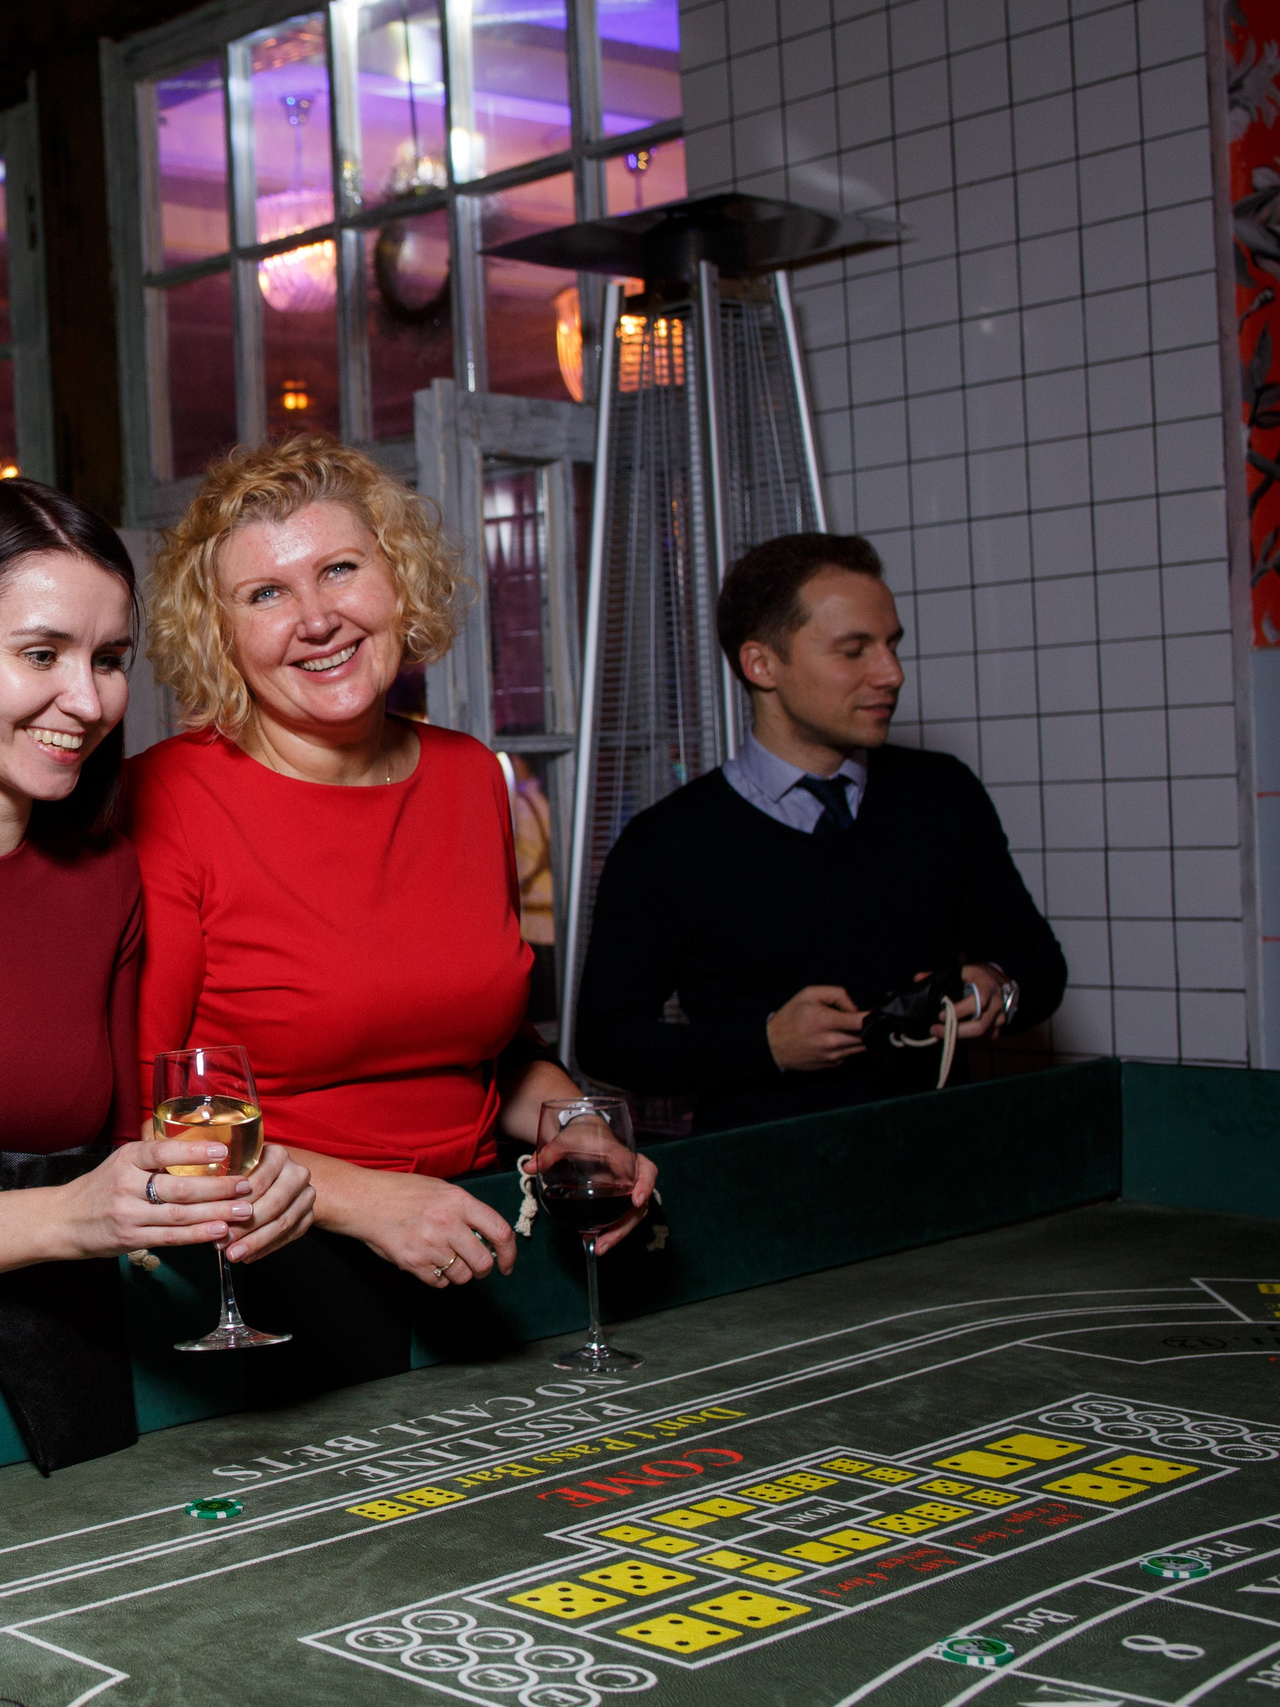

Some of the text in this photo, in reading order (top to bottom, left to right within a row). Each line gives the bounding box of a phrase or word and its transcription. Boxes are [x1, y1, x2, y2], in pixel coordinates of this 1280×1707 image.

[212, 1374, 628, 1482] NO CALL BETS
[337, 1401, 641, 1482] PASS LINE
[452, 1406, 748, 1488] Don't Pass Bar
[537, 1448, 744, 1508] COME
[1178, 1541, 1255, 1560] Pla
[1002, 1607, 1079, 1634] Bet
[1122, 1635, 1205, 1660] 8
